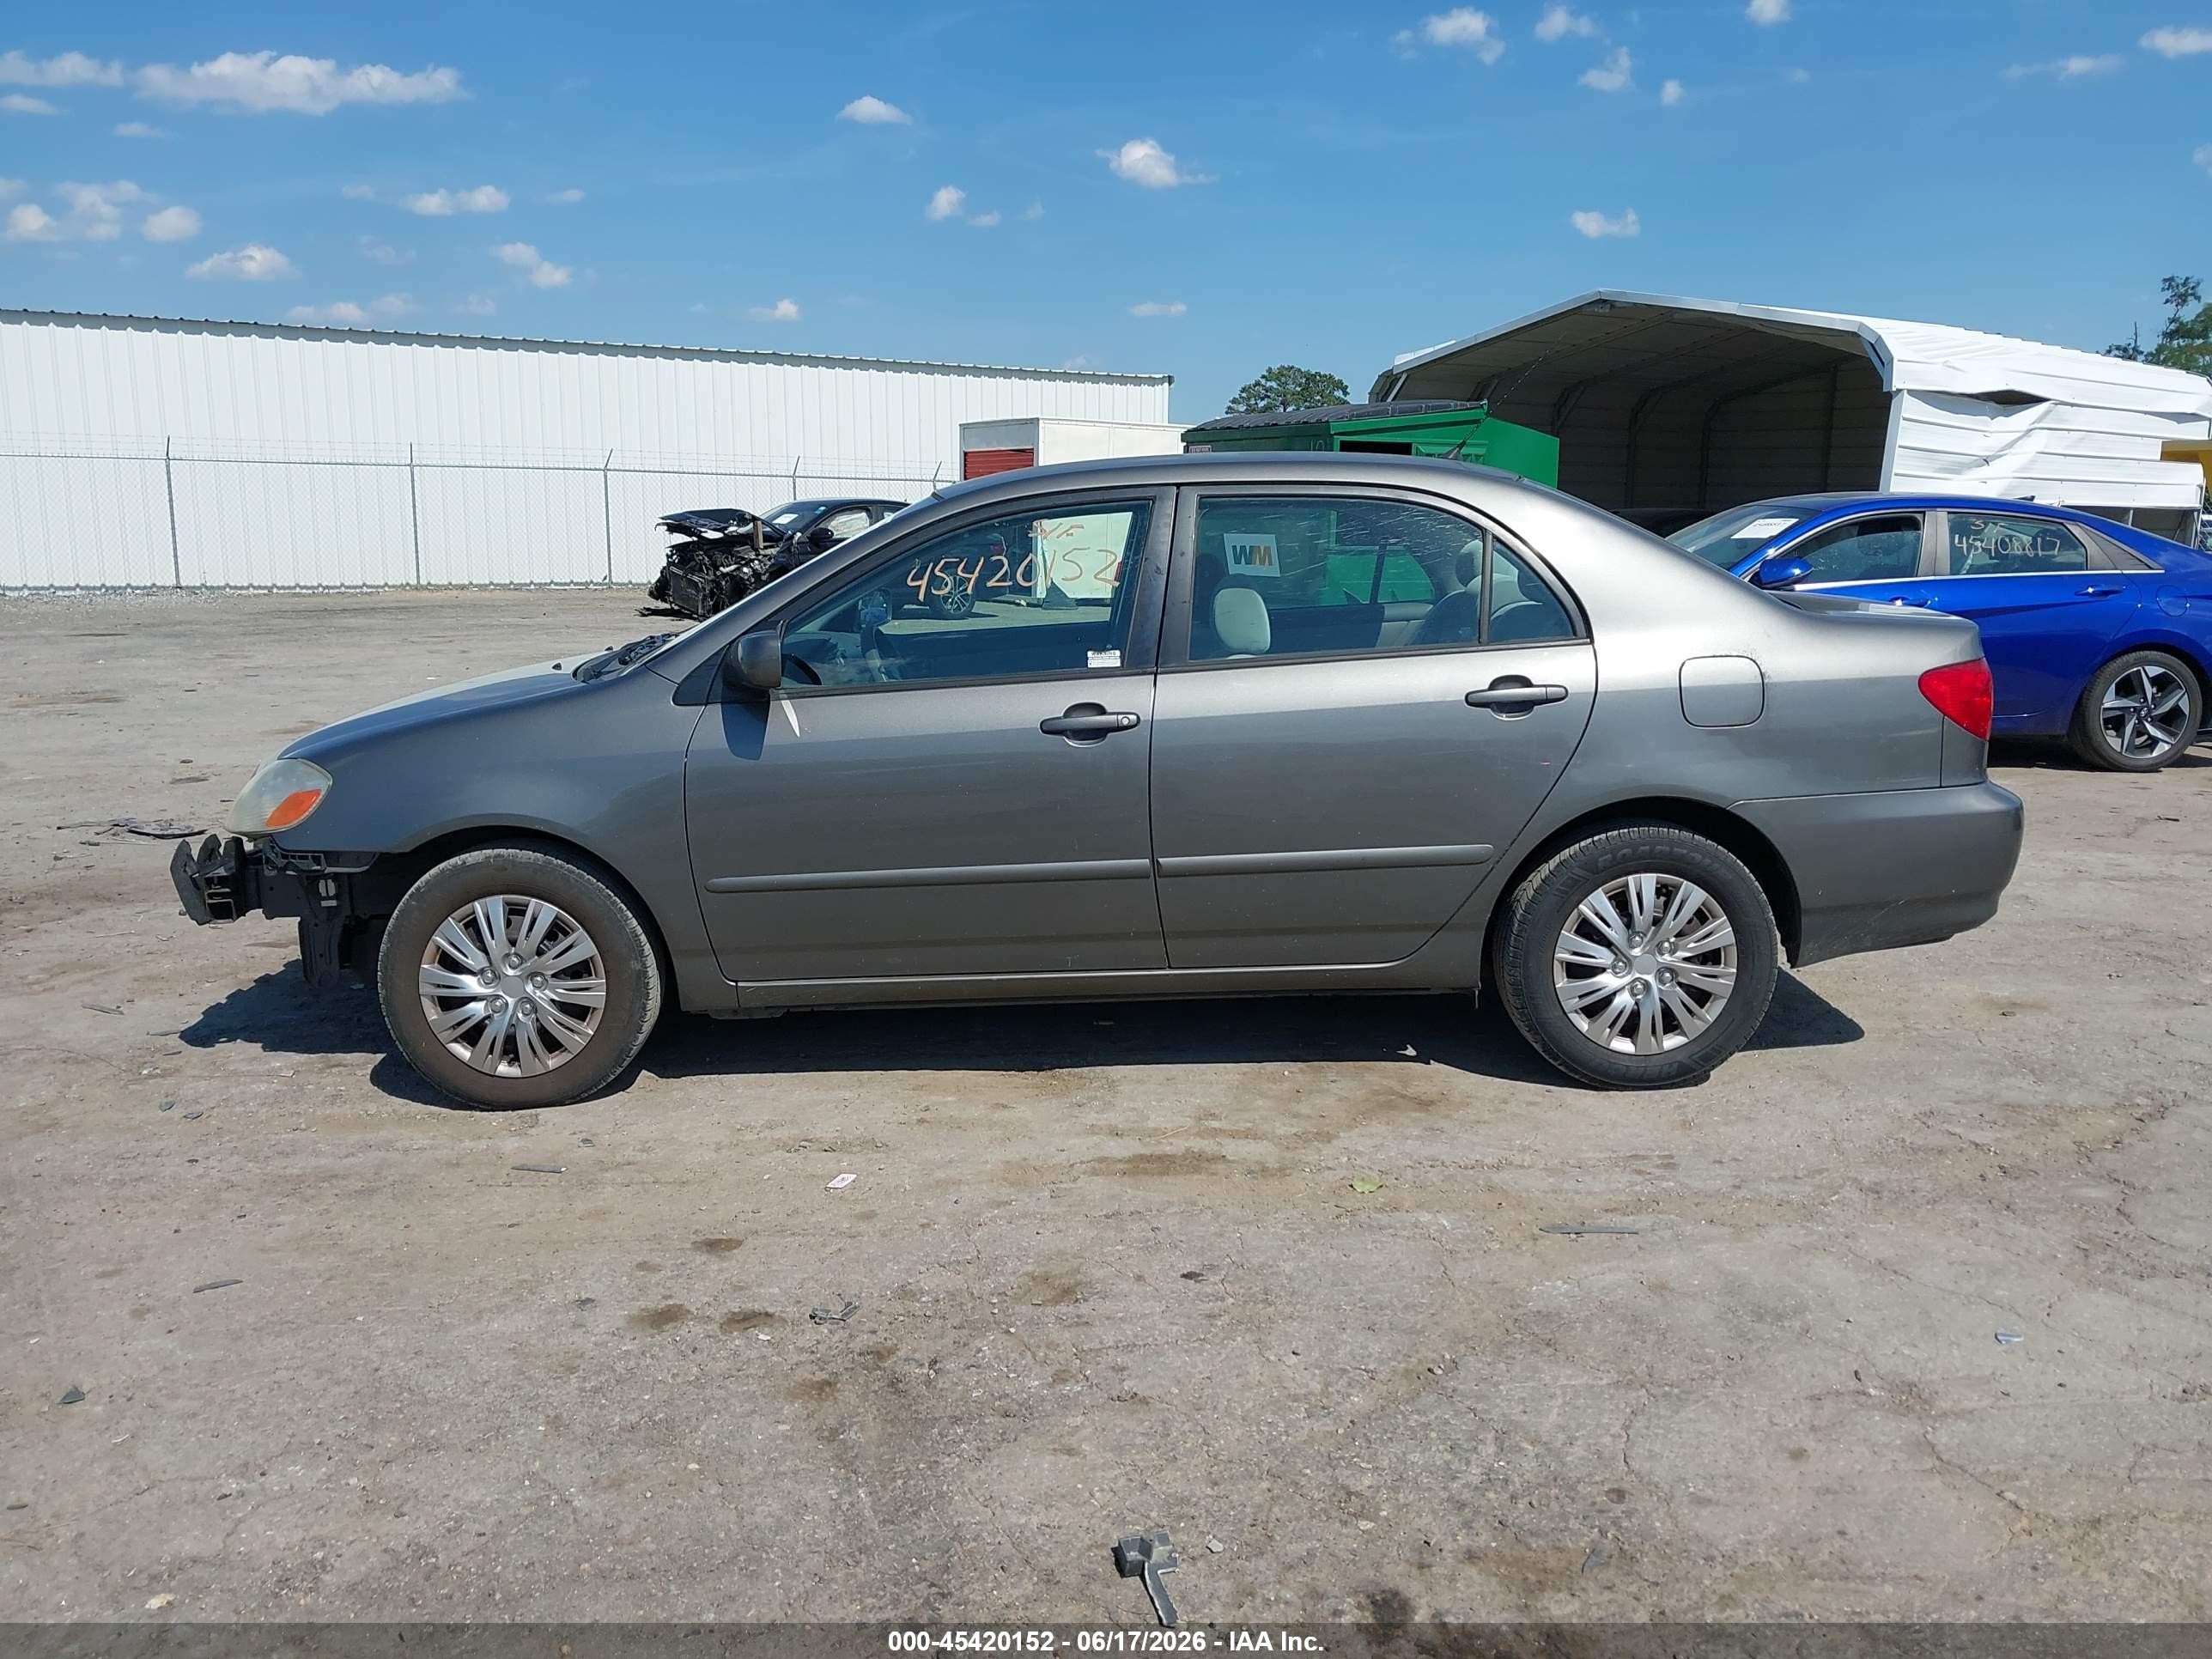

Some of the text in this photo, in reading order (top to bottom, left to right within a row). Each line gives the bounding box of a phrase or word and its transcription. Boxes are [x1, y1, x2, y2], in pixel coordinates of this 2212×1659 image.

[1231, 544, 1273, 566] WM
[1954, 533, 2061, 558] 45408817
[906, 546, 1121, 602] 45420152
